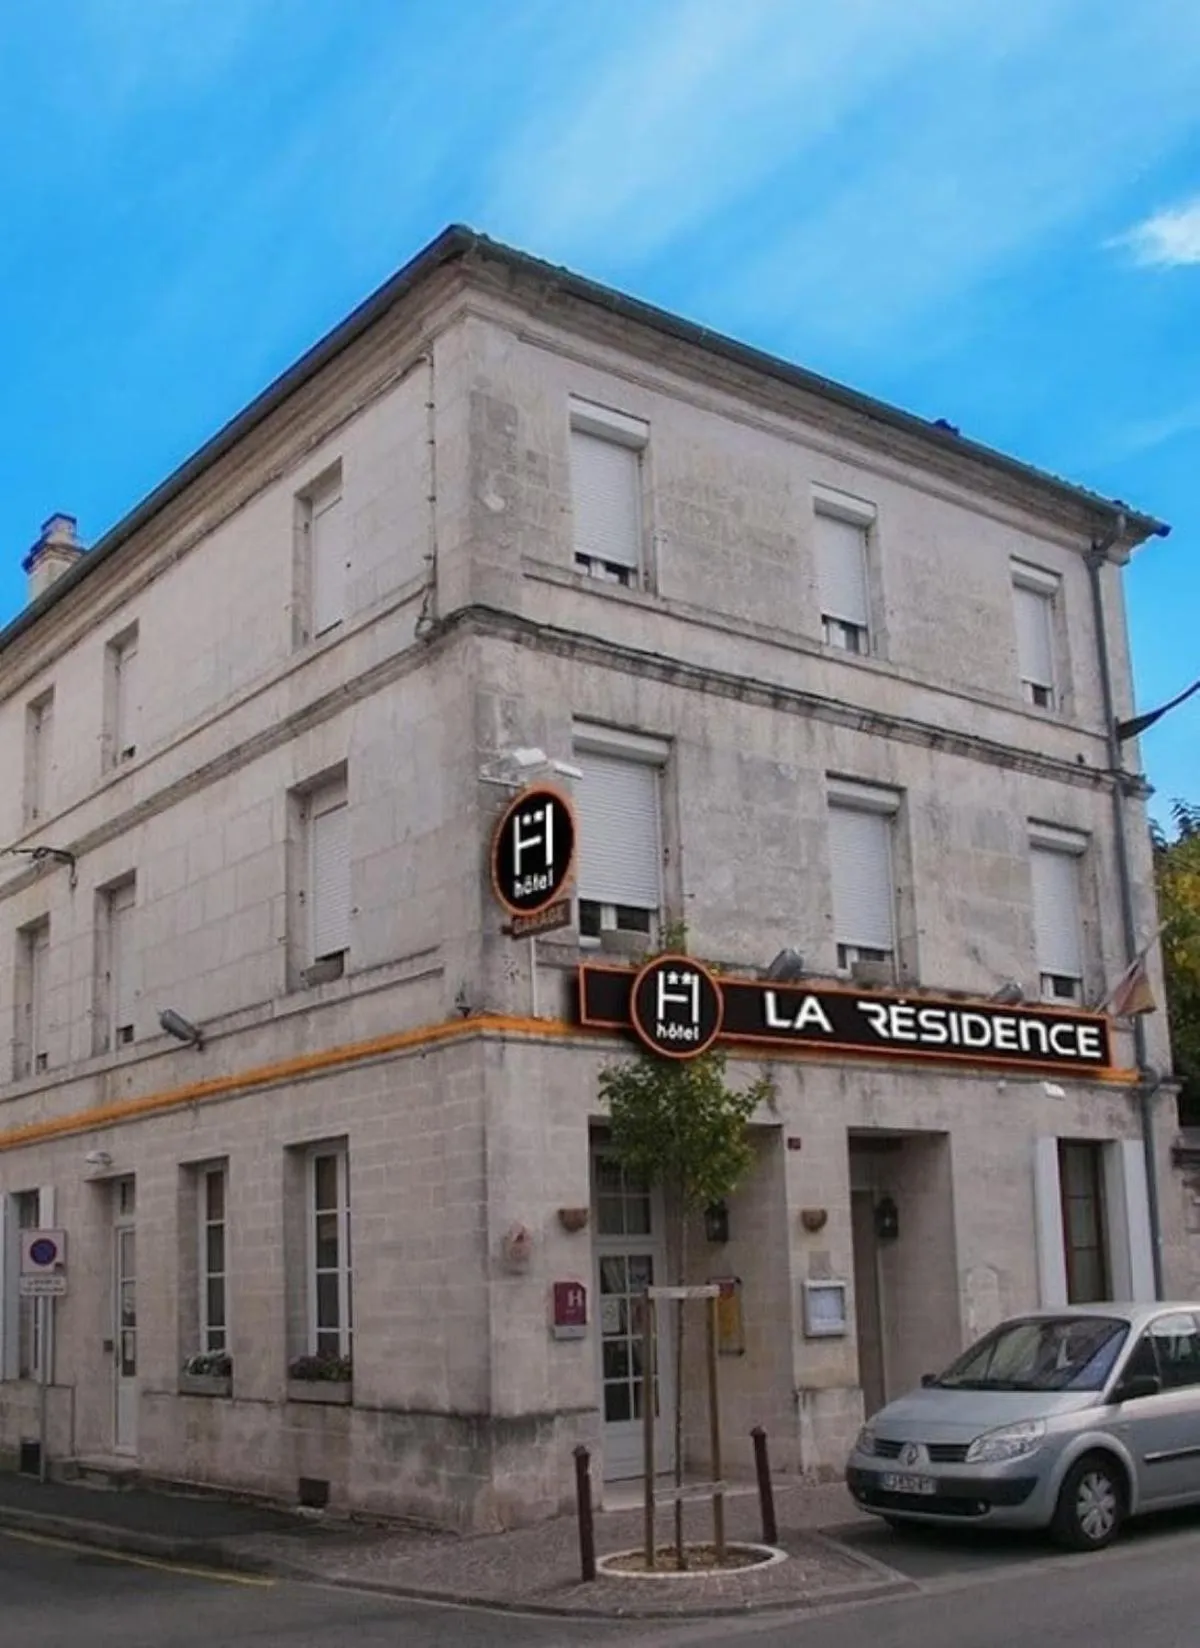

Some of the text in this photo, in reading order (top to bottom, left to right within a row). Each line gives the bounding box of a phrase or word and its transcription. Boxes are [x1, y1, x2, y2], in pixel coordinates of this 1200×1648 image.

[513, 868, 554, 898] hôtel
[764, 991, 834, 1032] LA
[656, 1023, 700, 1041] hôtel
[567, 1289, 583, 1307] H
